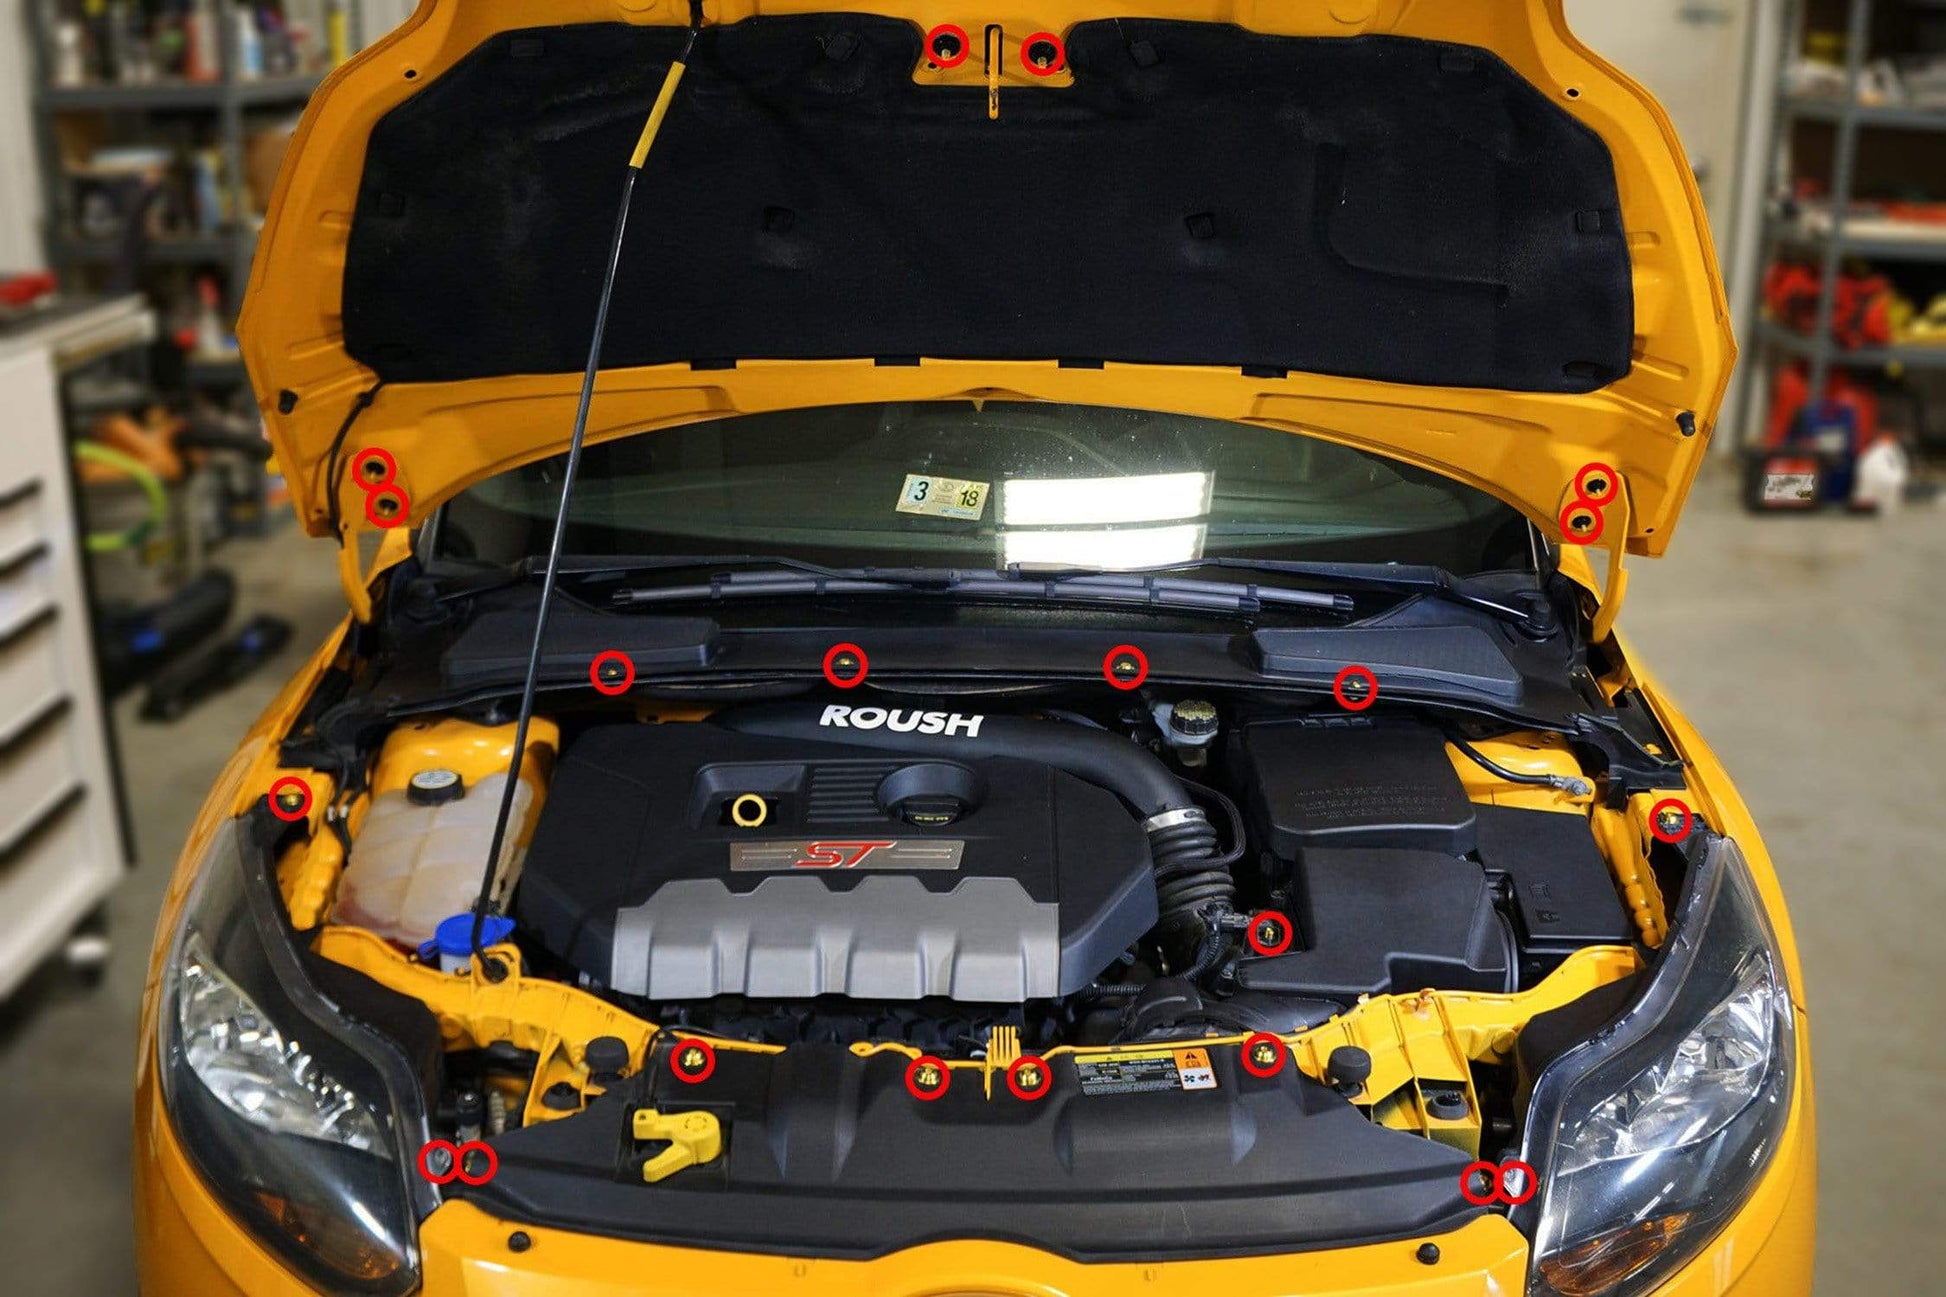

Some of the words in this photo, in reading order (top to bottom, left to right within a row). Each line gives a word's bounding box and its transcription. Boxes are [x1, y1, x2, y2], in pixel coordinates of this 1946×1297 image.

[914, 481, 929, 501] 3
[961, 490, 979, 507] 18
[819, 704, 984, 737] ROUSH
[795, 841, 897, 867] ST
